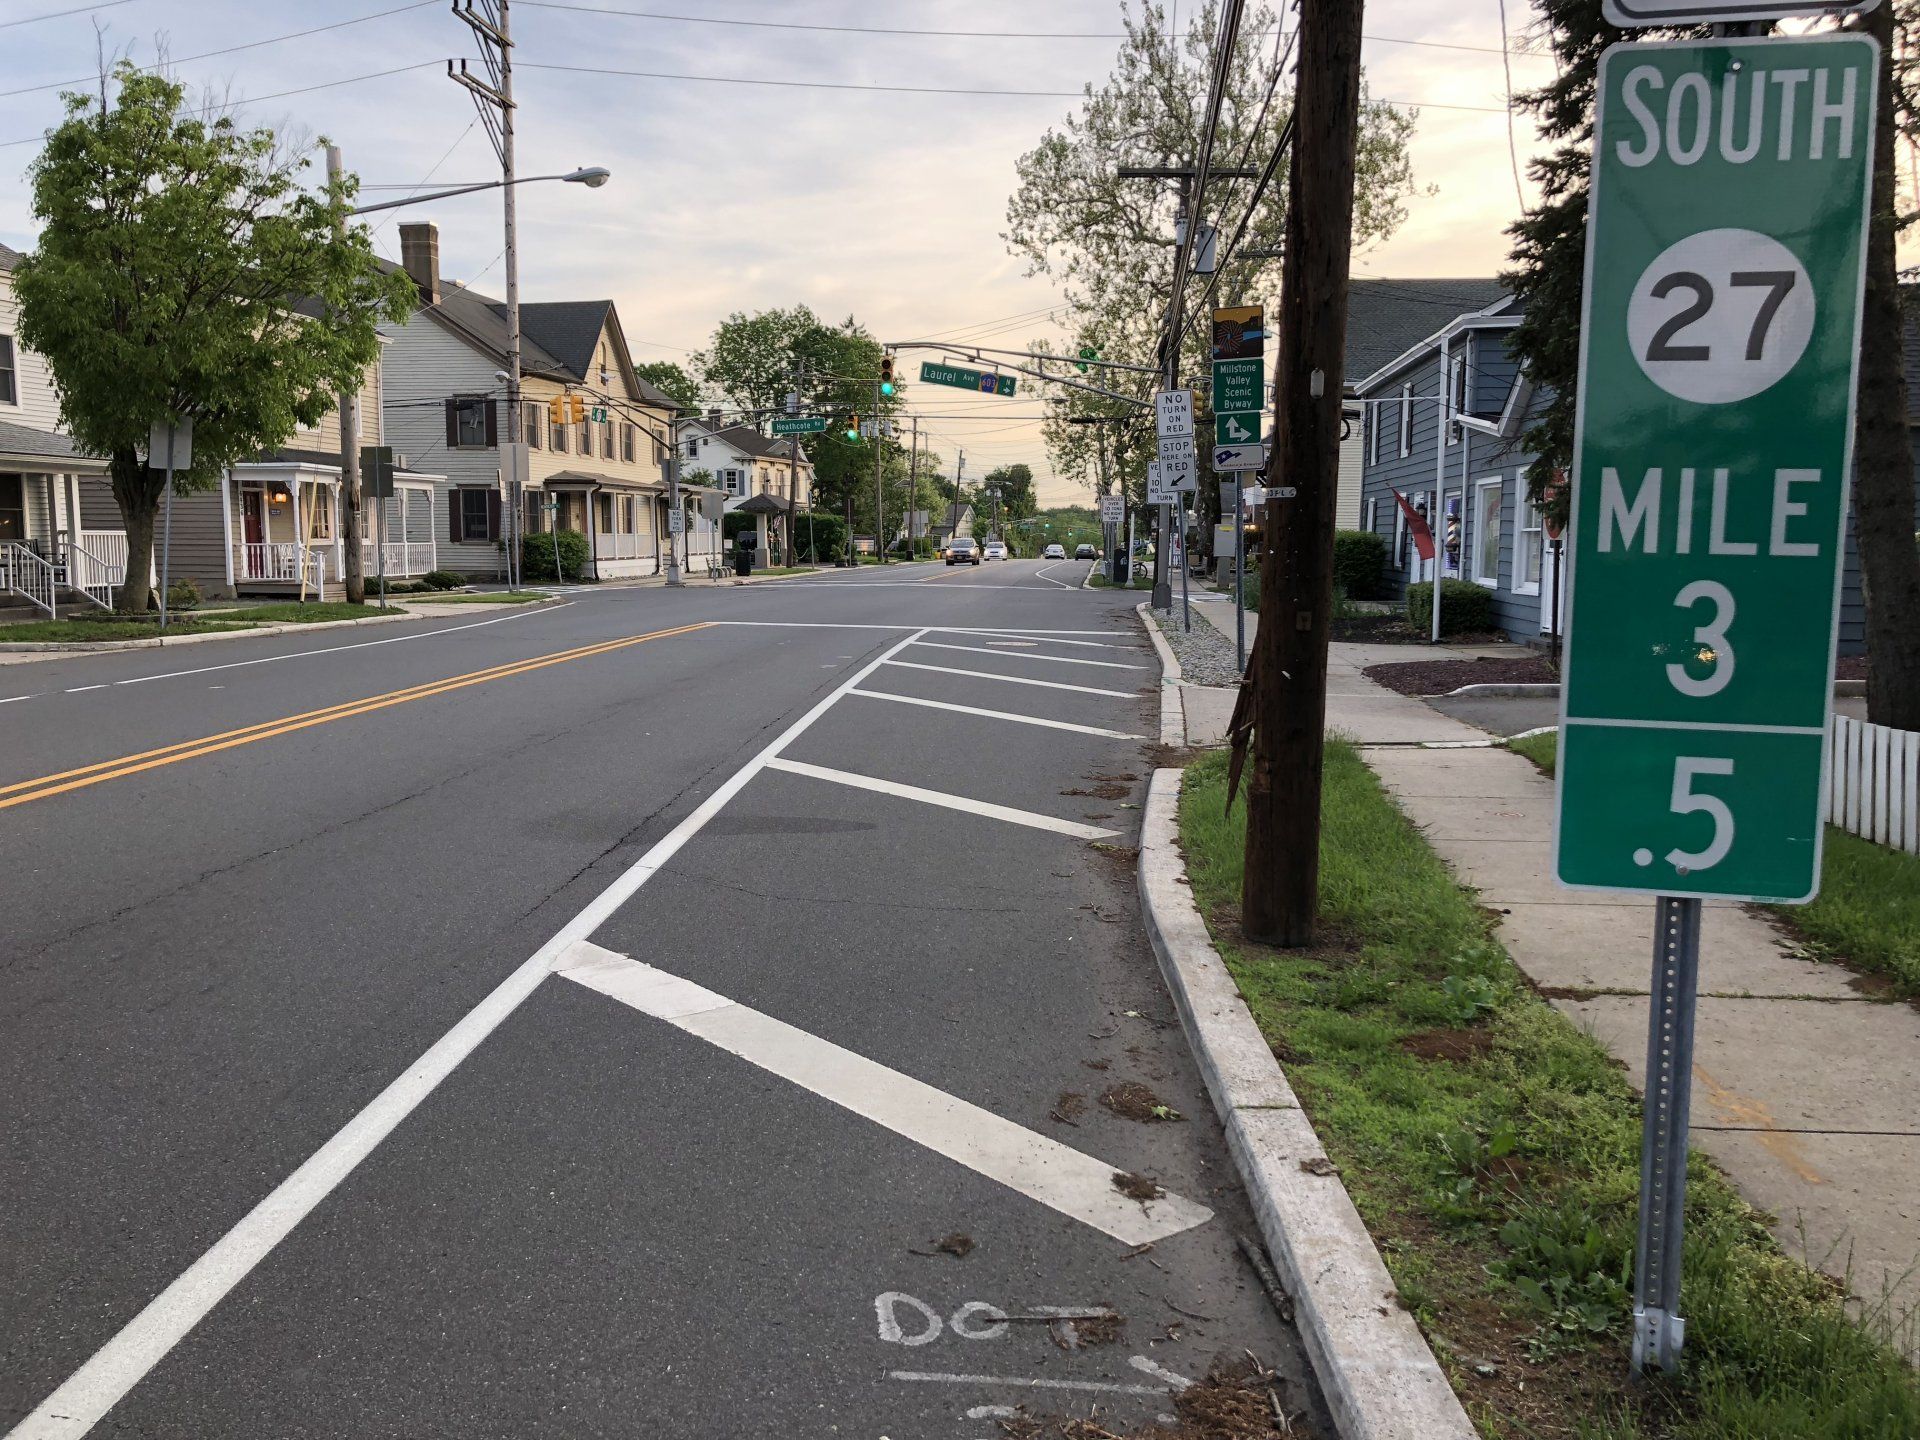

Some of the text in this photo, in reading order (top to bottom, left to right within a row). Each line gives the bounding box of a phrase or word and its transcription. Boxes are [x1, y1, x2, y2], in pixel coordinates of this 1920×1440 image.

[1616, 65, 1857, 167] SOUTH
[1645, 271, 1796, 361] 27
[1220, 364, 1257, 374] Millstone
[923, 366, 1011, 388] Laurel Ave 603 N
[1226, 376, 1251, 386] Valley
[1225, 388, 1252, 397] Scenic
[1165, 394, 1183, 404] NO
[1162, 405, 1187, 414] TURN
[1224, 399, 1252, 411] Byway
[1168, 415, 1181, 423] ON
[776, 422, 811, 431] Heathcote
[1166, 424, 1184, 433] RED
[1163, 441, 1190, 452] STOP
[1161, 453, 1179, 461] HERE
[1167, 461, 1188, 472] RED
[1597, 467, 1821, 557] MILE
[1665, 580, 1736, 697] 3
[1632, 756, 1735, 871] .5
